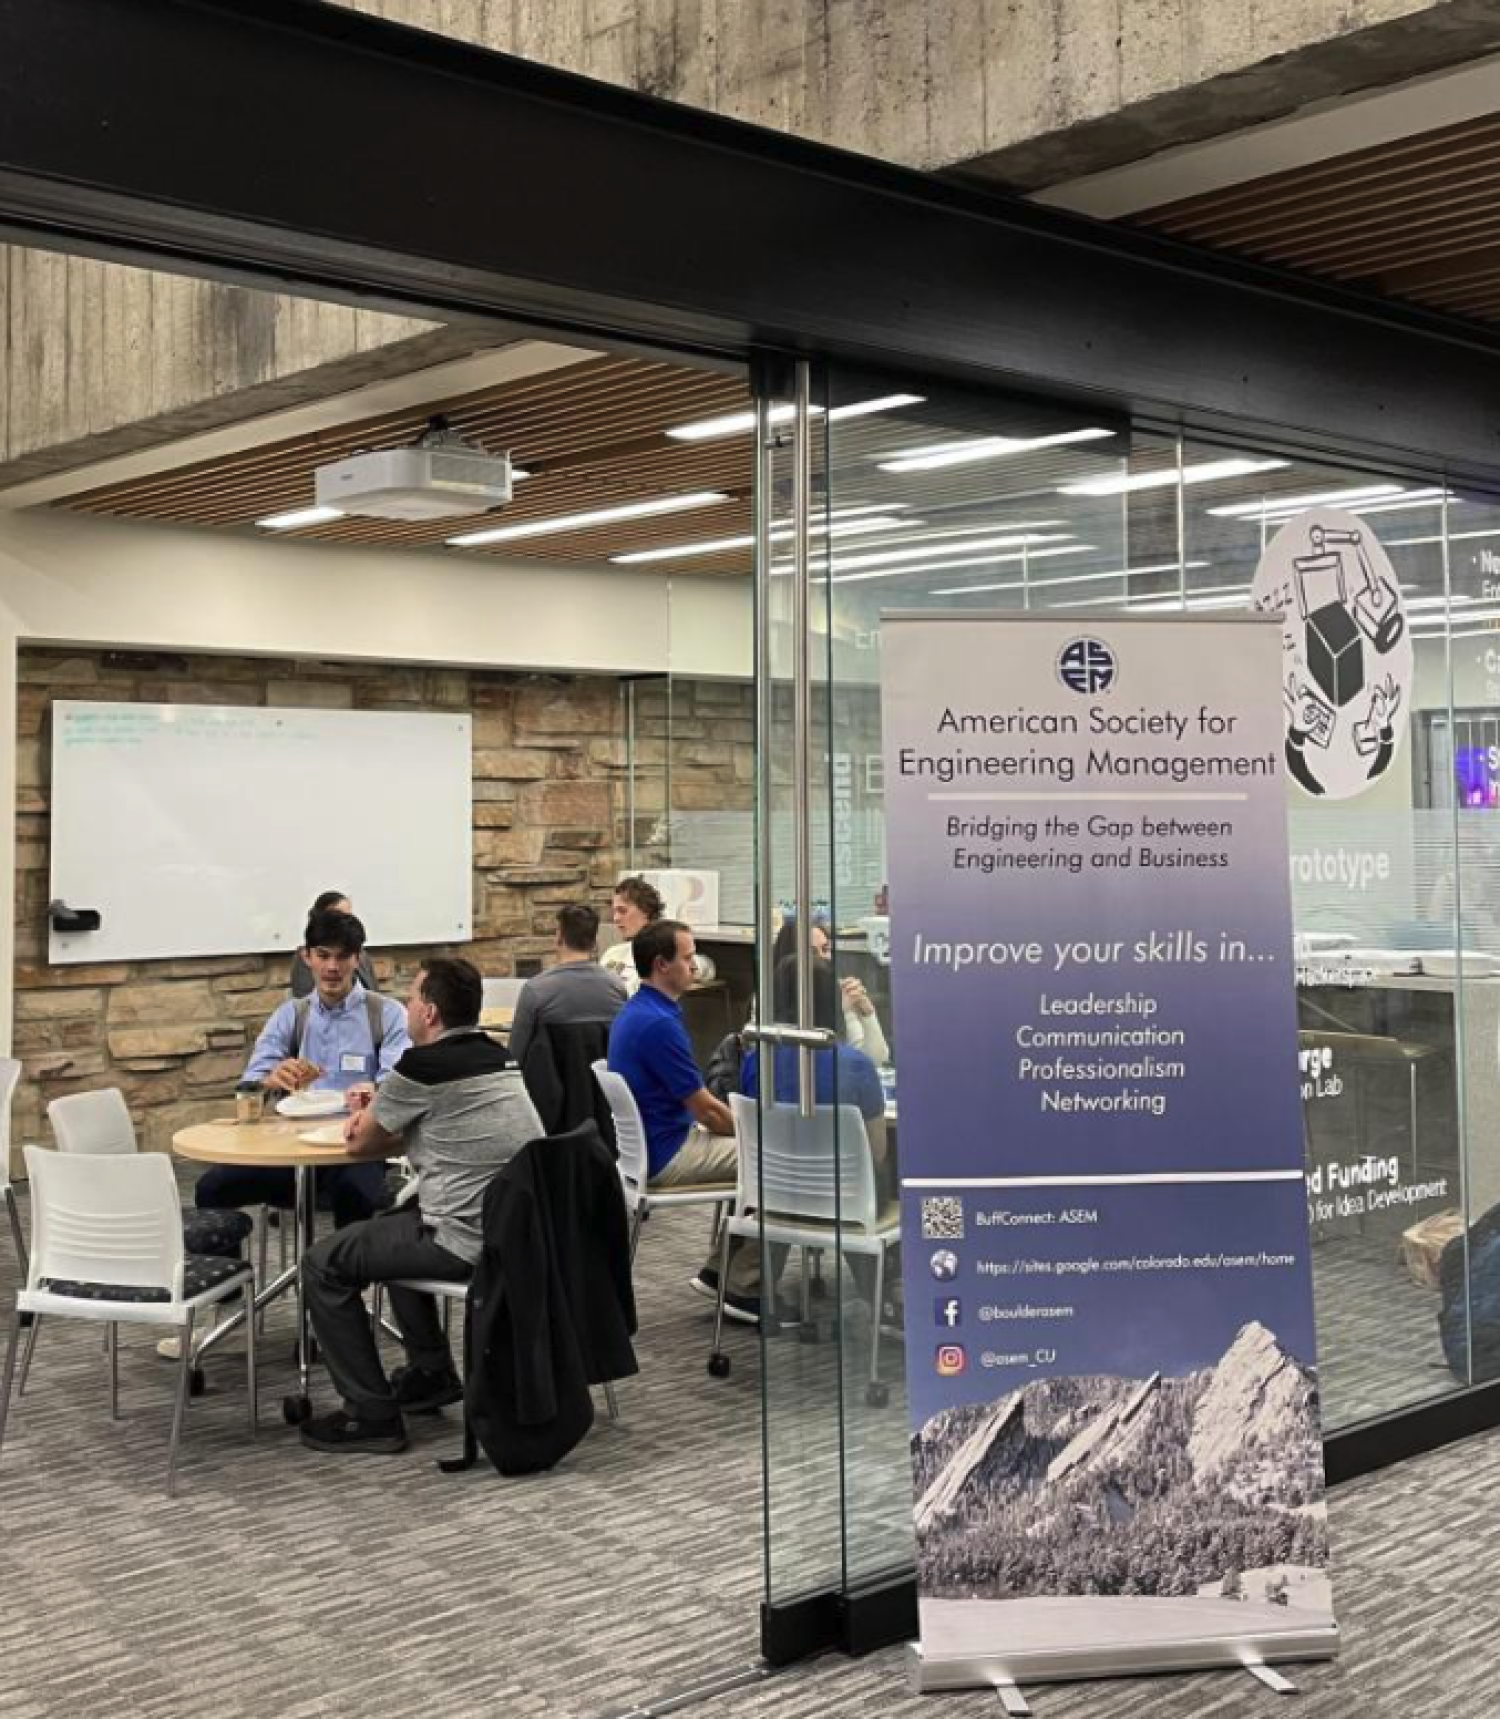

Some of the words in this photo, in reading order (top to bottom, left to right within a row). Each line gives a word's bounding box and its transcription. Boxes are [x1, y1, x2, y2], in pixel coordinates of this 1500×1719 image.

[937, 707, 1077, 734] American
[1089, 707, 1188, 739] Society
[1198, 706, 1237, 733] for
[900, 749, 1075, 782] Engineering
[1086, 751, 1277, 782] Management
[946, 815, 1038, 841] Bridging
[1045, 816, 1080, 836] the
[1087, 816, 1133, 841] Gap
[1141, 815, 1233, 836] between
[953, 848, 1083, 873] Engineering
[1090, 847, 1132, 868] and
[1139, 847, 1229, 868] Business
[1289, 847, 1390, 892] rototype
[913, 933, 1044, 972] Improve
[1054, 936, 1124, 971] your
[1133, 930, 1208, 962] skills
[1219, 931, 1275, 962] in...
[1040, 993, 1158, 1019] Leadership
[1016, 1025, 1185, 1049] Communication
[1018, 1056, 1185, 1081] Professionalism
[1298, 1046, 1333, 1080] rge
[1315, 1074, 1344, 1098] Lab
[1040, 1089, 1167, 1115] Networking
[1326, 1155, 1399, 1191] Funding
[1315, 1200, 1334, 1222] for
[1366, 1177, 1448, 1211] Development
[976, 1210, 1056, 1226] BuffConnect:
[1059, 1208, 1099, 1225] ASEM
[978, 1303, 1075, 1322] @boulderasem
[980, 1348, 1057, 1368] @asem_CU
